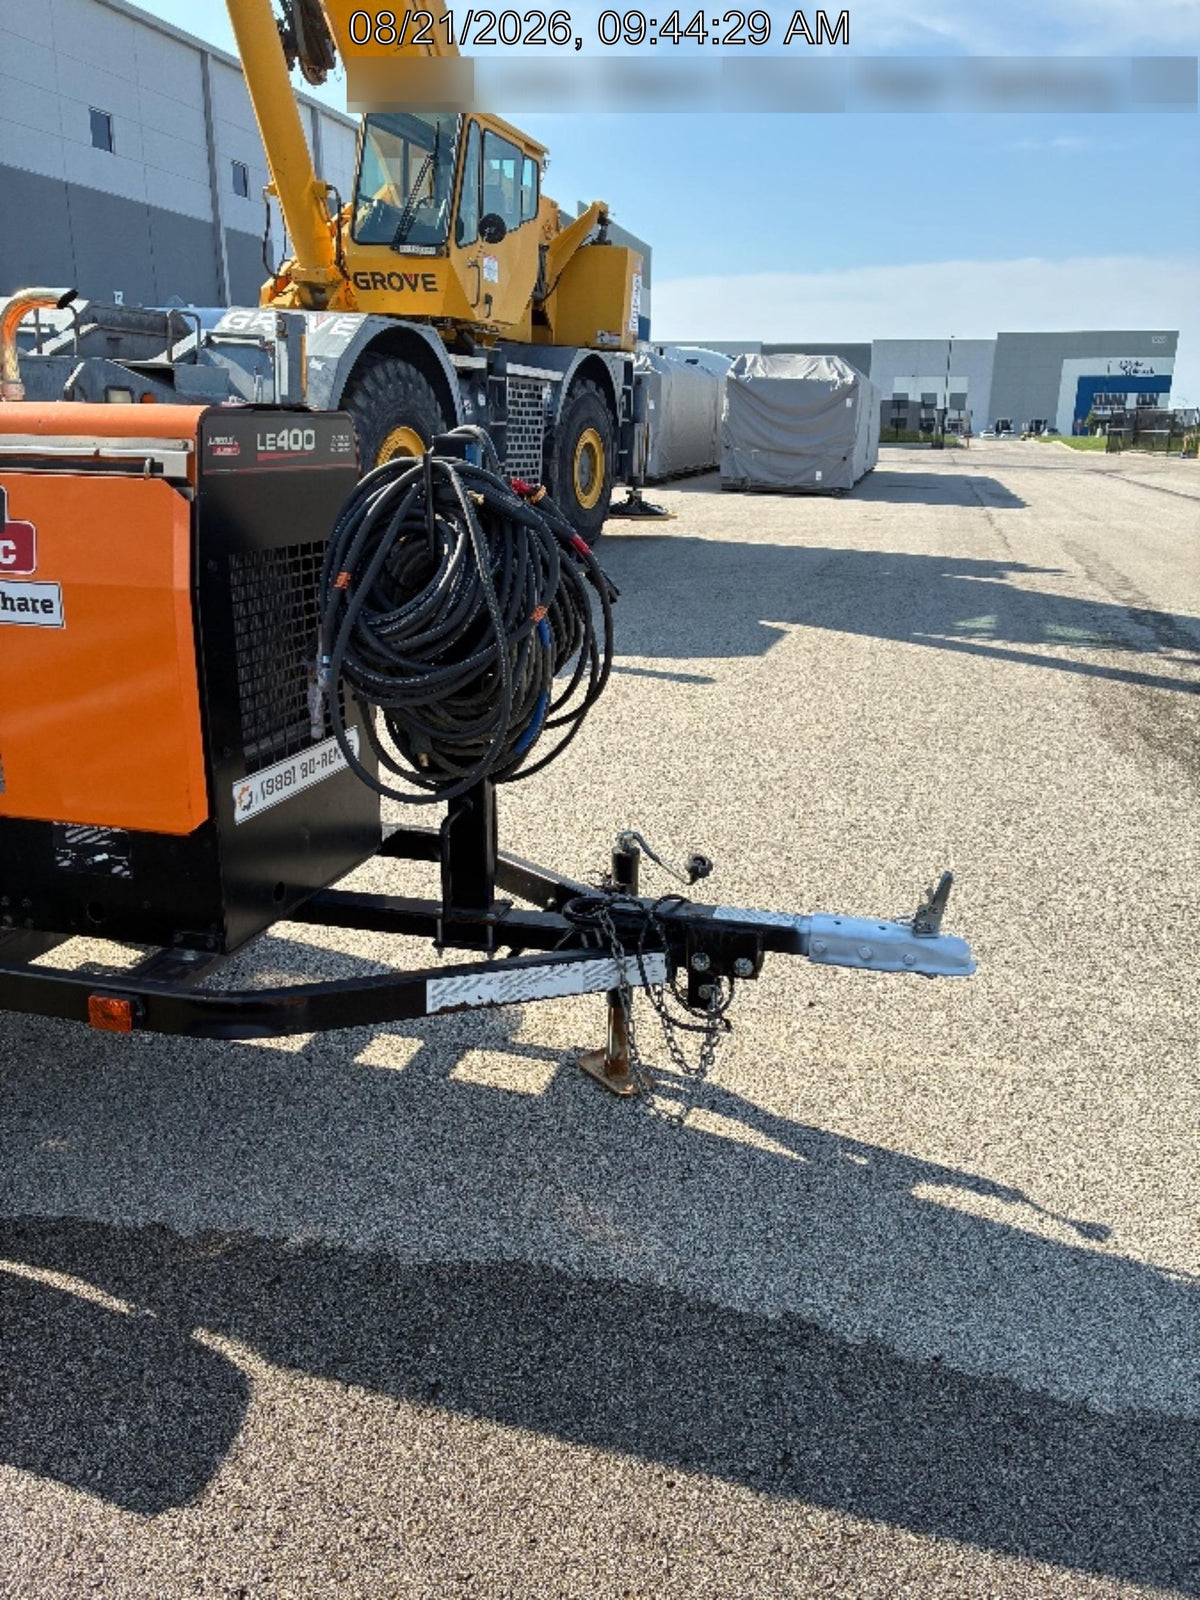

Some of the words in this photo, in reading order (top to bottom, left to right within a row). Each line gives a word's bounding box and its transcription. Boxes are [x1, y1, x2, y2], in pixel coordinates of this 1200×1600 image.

[353, 271, 438, 292] GROVE
[221, 310, 363, 336] GRVE
[257, 428, 315, 451] LE400
